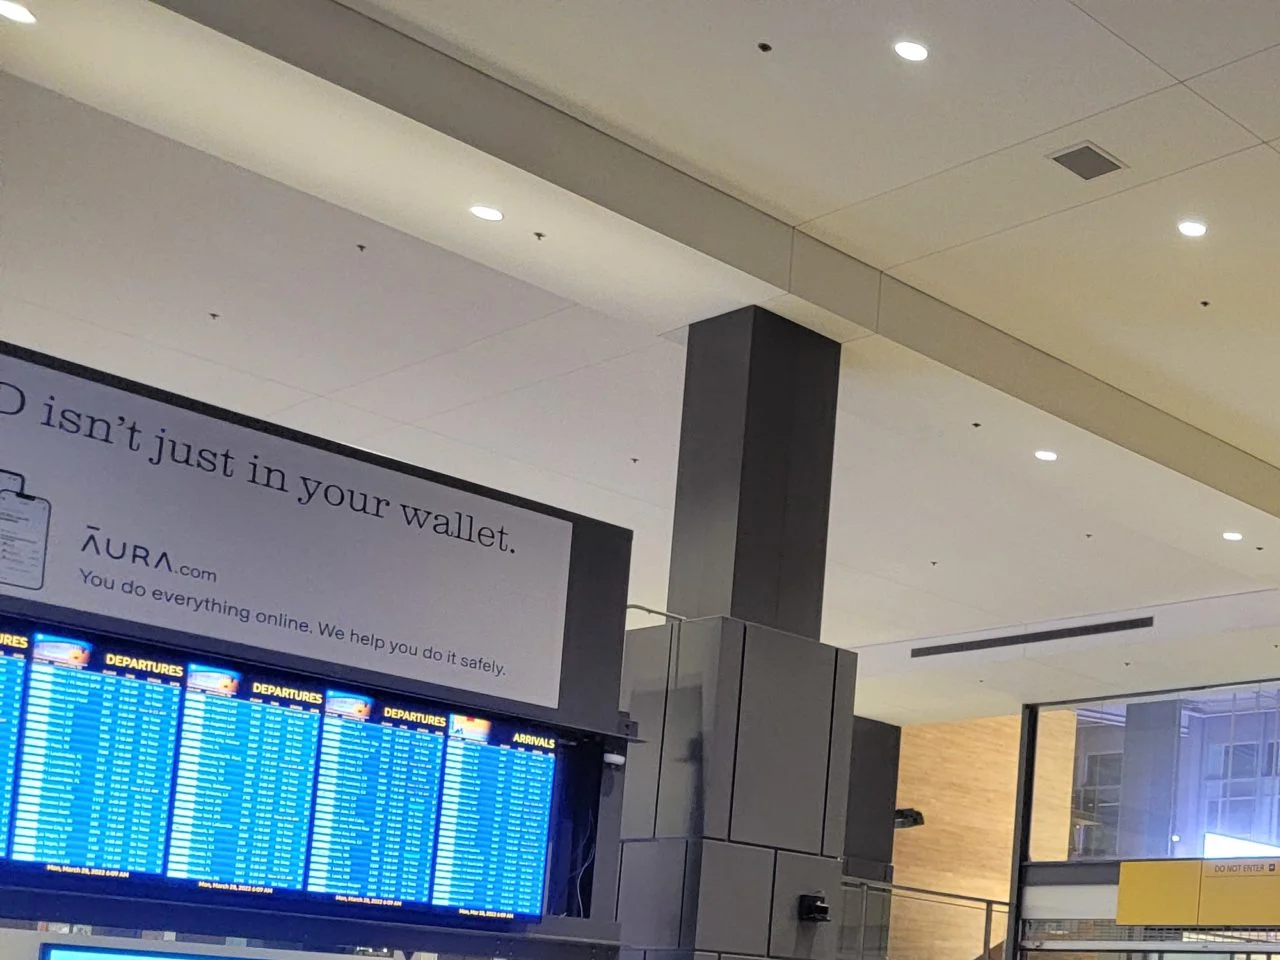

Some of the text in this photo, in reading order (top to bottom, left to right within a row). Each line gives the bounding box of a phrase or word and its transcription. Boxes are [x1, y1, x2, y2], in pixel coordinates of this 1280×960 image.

[148, 428, 235, 479] just
[247, 454, 289, 493] in
[297, 475, 390, 519] your
[400, 503, 516, 555] wallet.
[79, 567, 507, 678] You do everything online. We help you do it safely.
[106, 653, 184, 678] DEPARTURES
[252, 682, 323, 705] DEPARTURES
[384, 706, 447, 727] DEPARTURES
[512, 733, 556, 749] ARRIVALS
[1214, 863, 1266, 873] DO NOT ENTER
